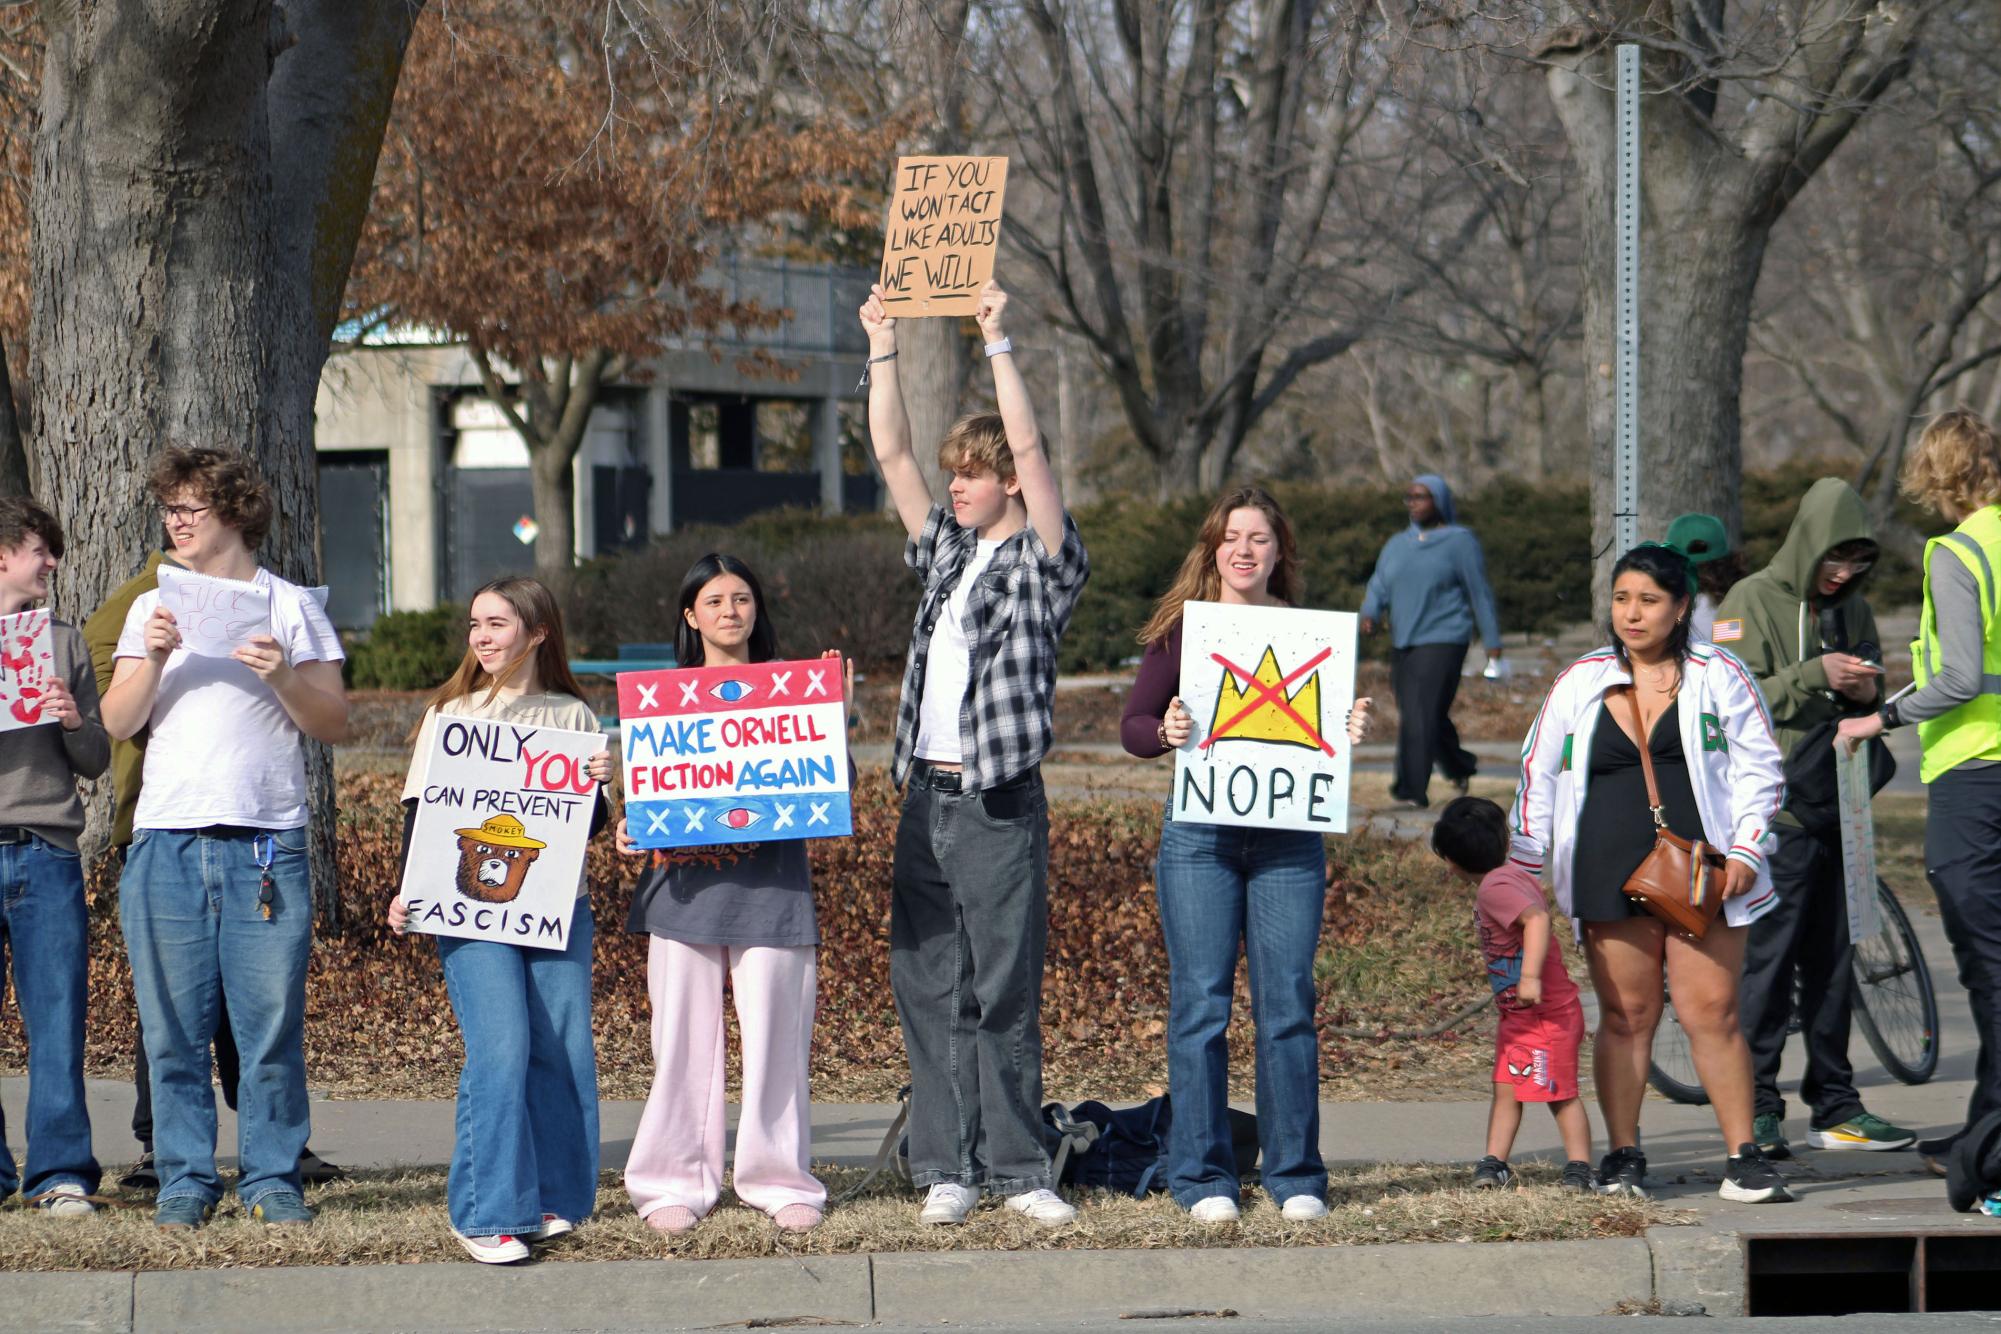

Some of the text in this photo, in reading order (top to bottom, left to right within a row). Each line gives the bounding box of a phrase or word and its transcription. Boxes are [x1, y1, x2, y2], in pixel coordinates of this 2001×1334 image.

[902, 161, 991, 192] IF YOU
[958, 190, 996, 214] ACT
[891, 218, 1000, 252] LIKE ADULTS
[884, 254, 980, 292] WE WILL
[178, 583, 248, 613] FUCK
[177, 612, 250, 641] ICE
[627, 714, 826, 762] MAKE ORWELL
[442, 722, 597, 795] ONLY YOU
[631, 754, 836, 795] FICTION AGAIN
[424, 785, 583, 824] CAN PREVENT
[1181, 764, 1335, 823] NOPE
[484, 823, 523, 835] SMOKEY
[406, 899, 563, 943] FASCISM
[1532, 1049, 1546, 1087] AMAZING
